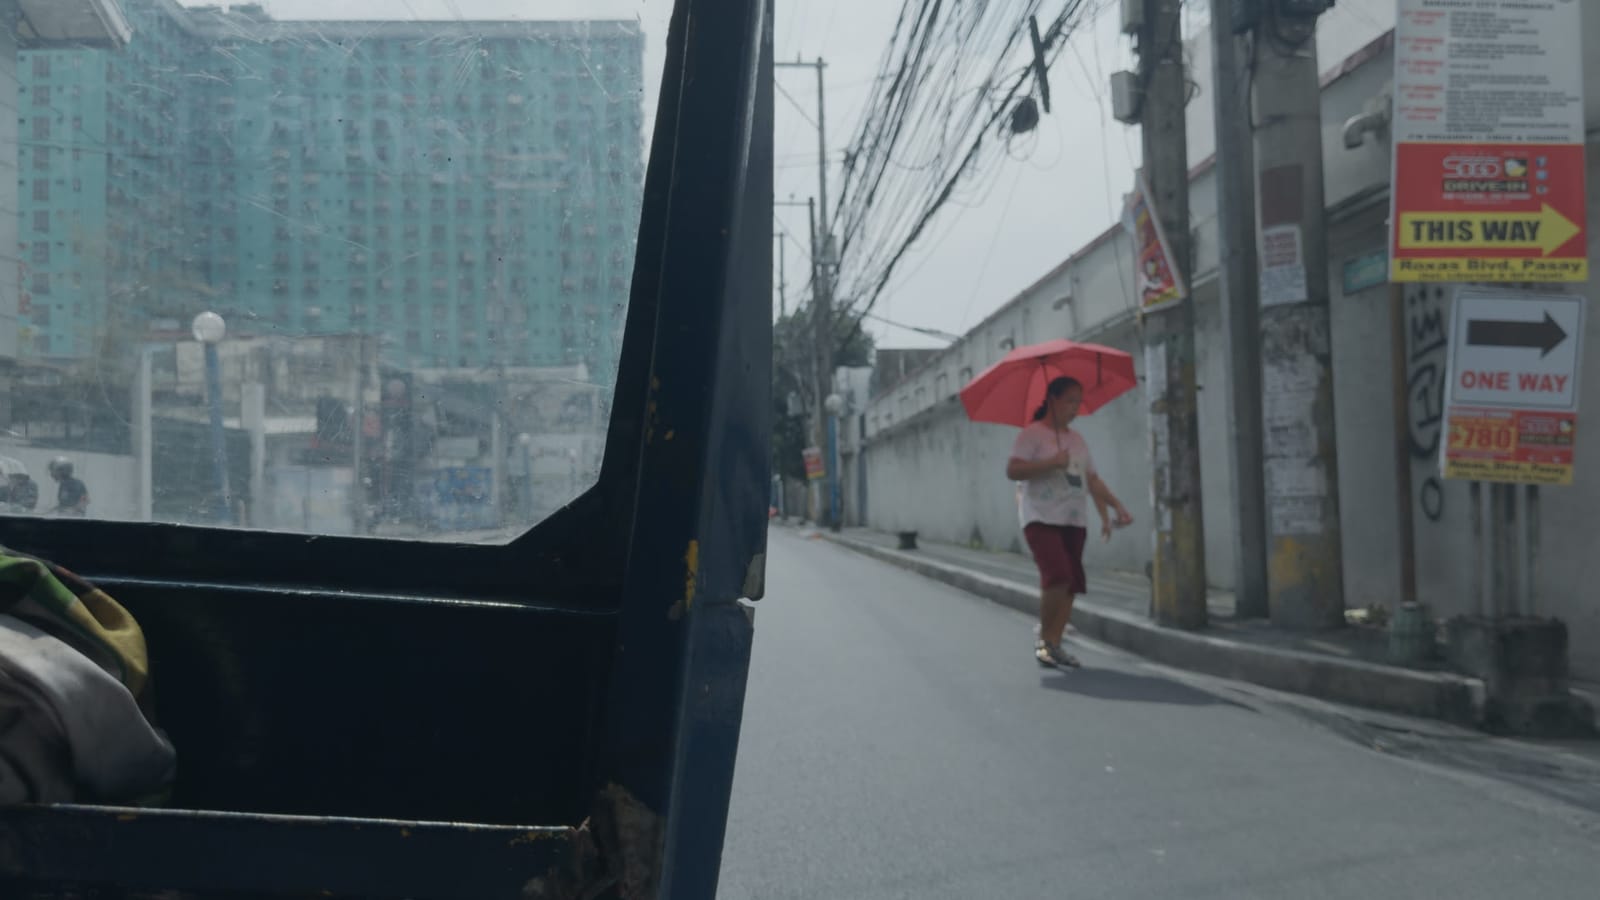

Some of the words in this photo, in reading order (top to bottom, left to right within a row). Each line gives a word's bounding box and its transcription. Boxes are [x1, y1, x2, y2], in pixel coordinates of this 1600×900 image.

[1410, 220, 1473, 241] THIS
[1480, 220, 1540, 241] WAY
[1400, 259, 1459, 270] Roxas
[1522, 260, 1581, 273] Pasay
[1460, 370, 1511, 391] ONE
[1519, 373, 1569, 394] WAY
